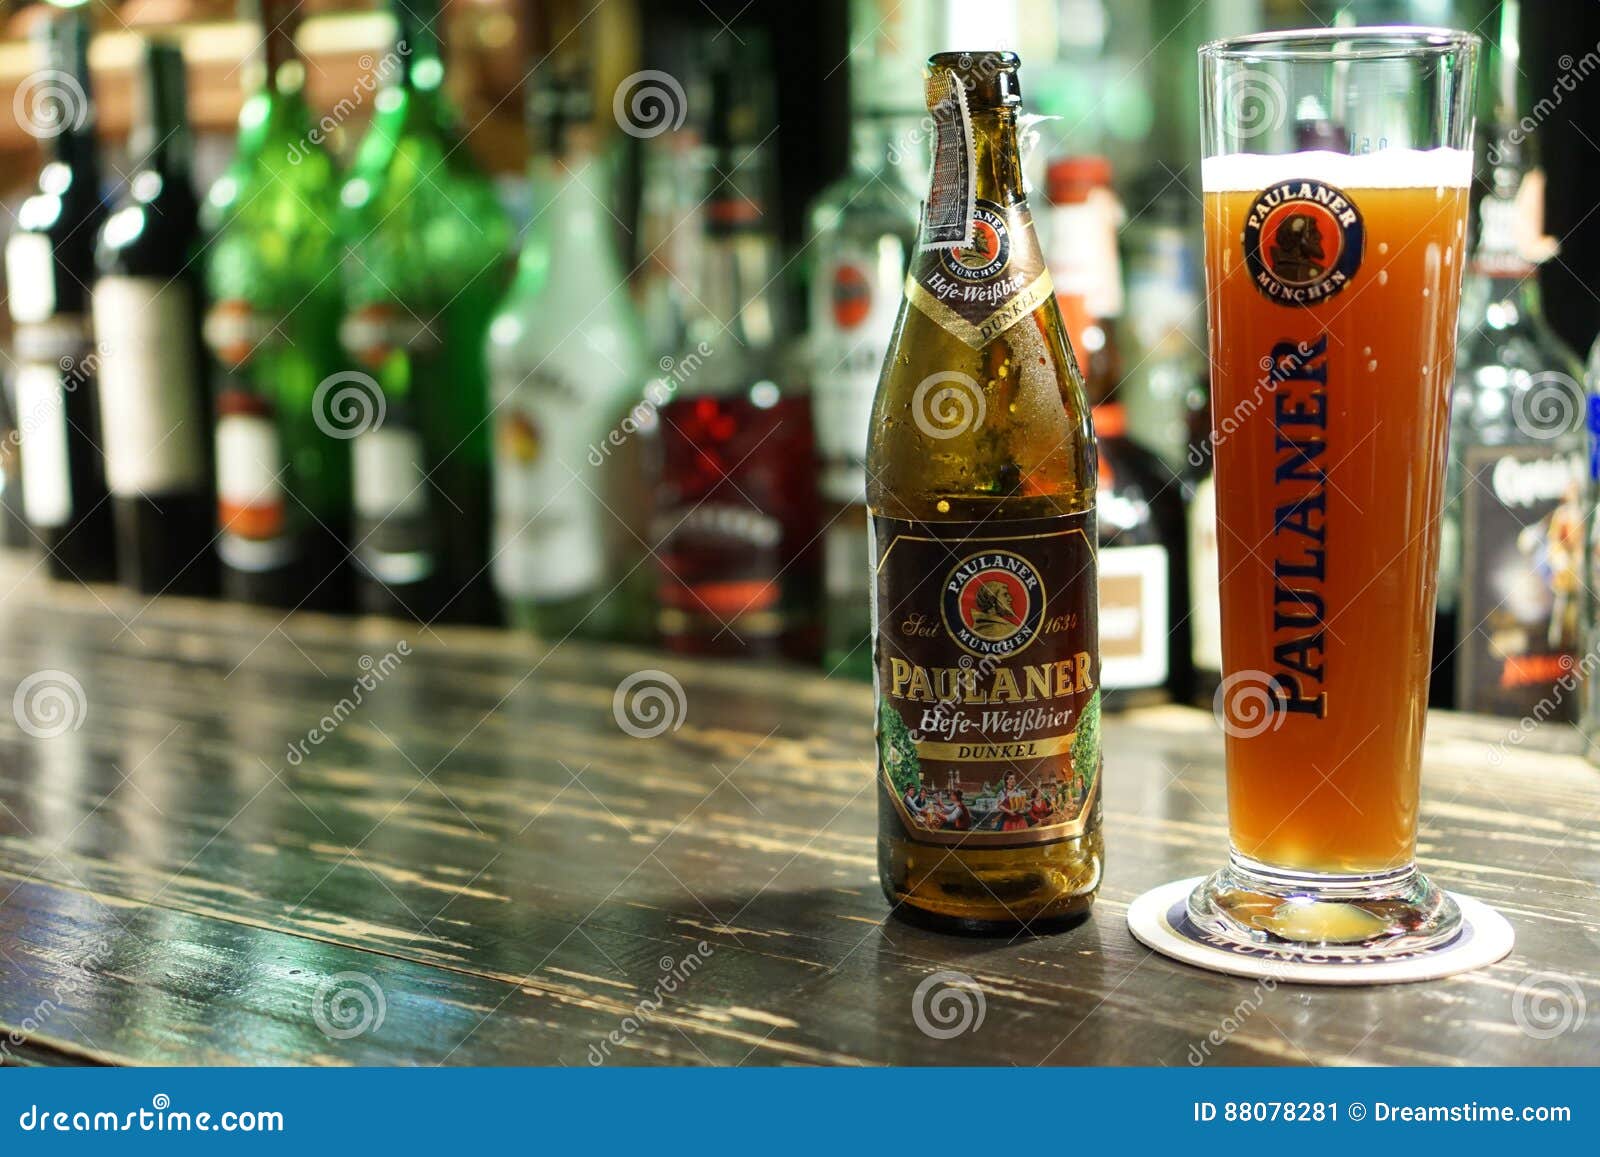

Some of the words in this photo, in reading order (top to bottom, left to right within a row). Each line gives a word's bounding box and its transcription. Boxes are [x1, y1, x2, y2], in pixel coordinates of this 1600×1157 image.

[1248, 183, 1357, 230] PAULANER
[1267, 333, 1328, 720] PAULANER
[948, 555, 1038, 594] PAULANER
[902, 613, 942, 638] Seit
[889, 651, 1094, 705] PAULANER
[919, 707, 1072, 742] Hefe-Weißbier
[957, 743, 1038, 759] DUNKEL
